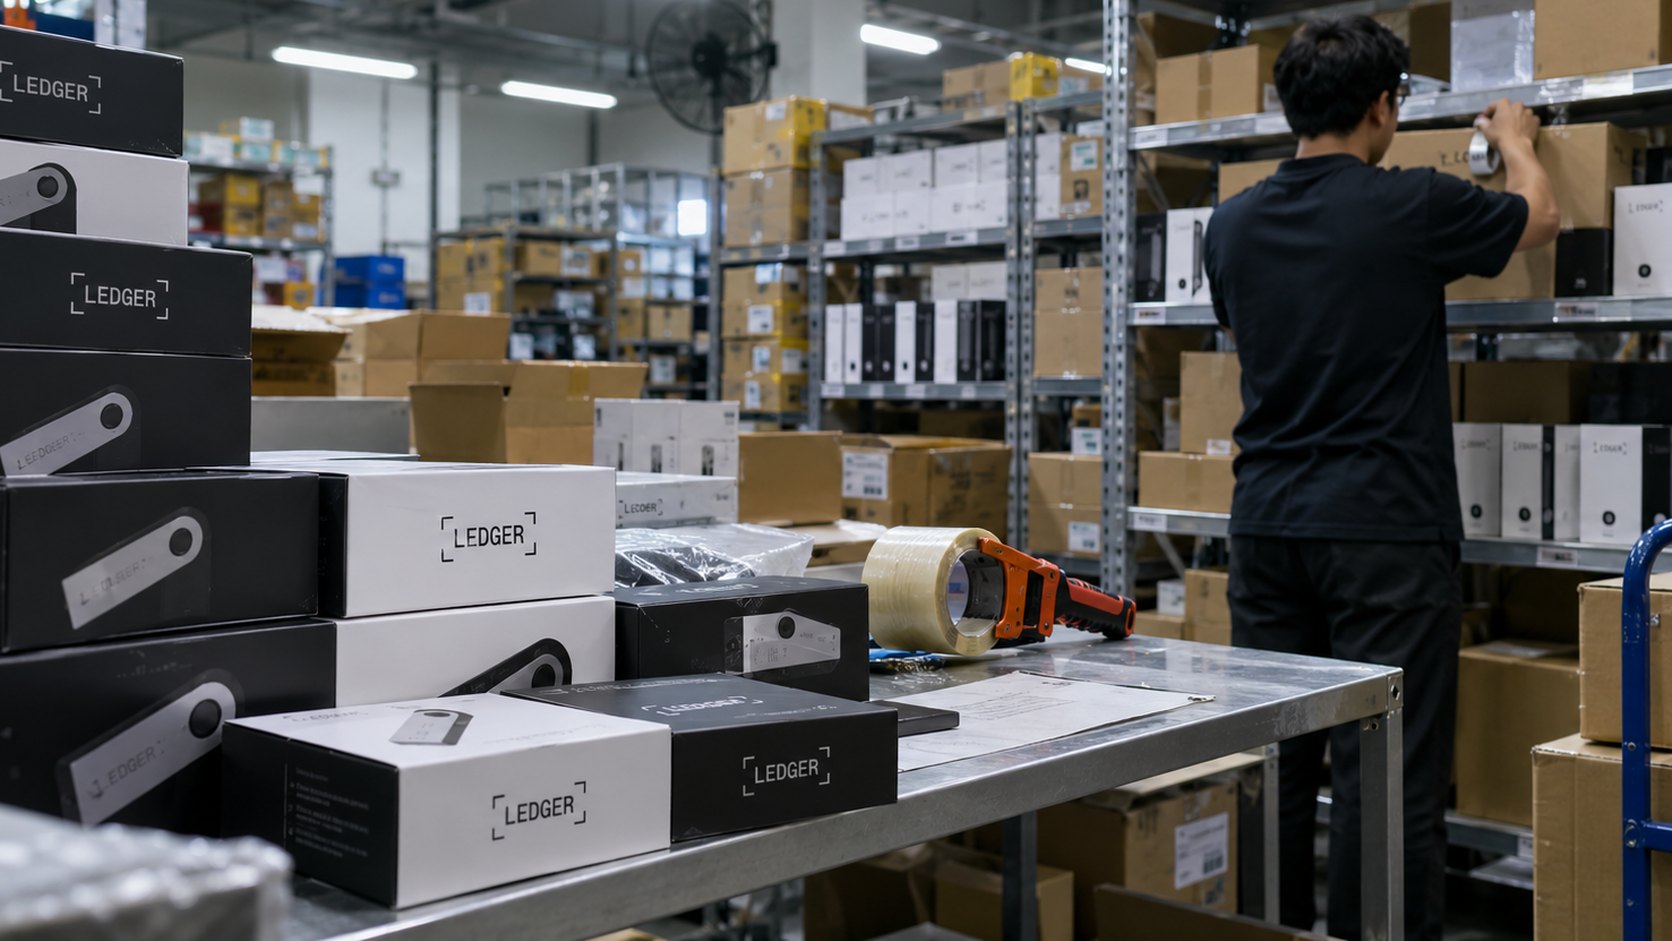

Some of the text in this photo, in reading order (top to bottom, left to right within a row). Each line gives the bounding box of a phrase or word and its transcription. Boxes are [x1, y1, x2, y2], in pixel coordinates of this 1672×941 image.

[13, 74, 89, 102] LEDGER
[84, 284, 157, 308] LEDGER
[454, 524, 525, 549] LEDGER
[754, 758, 819, 785] LEDGER
[504, 796, 575, 826] LEDGER
